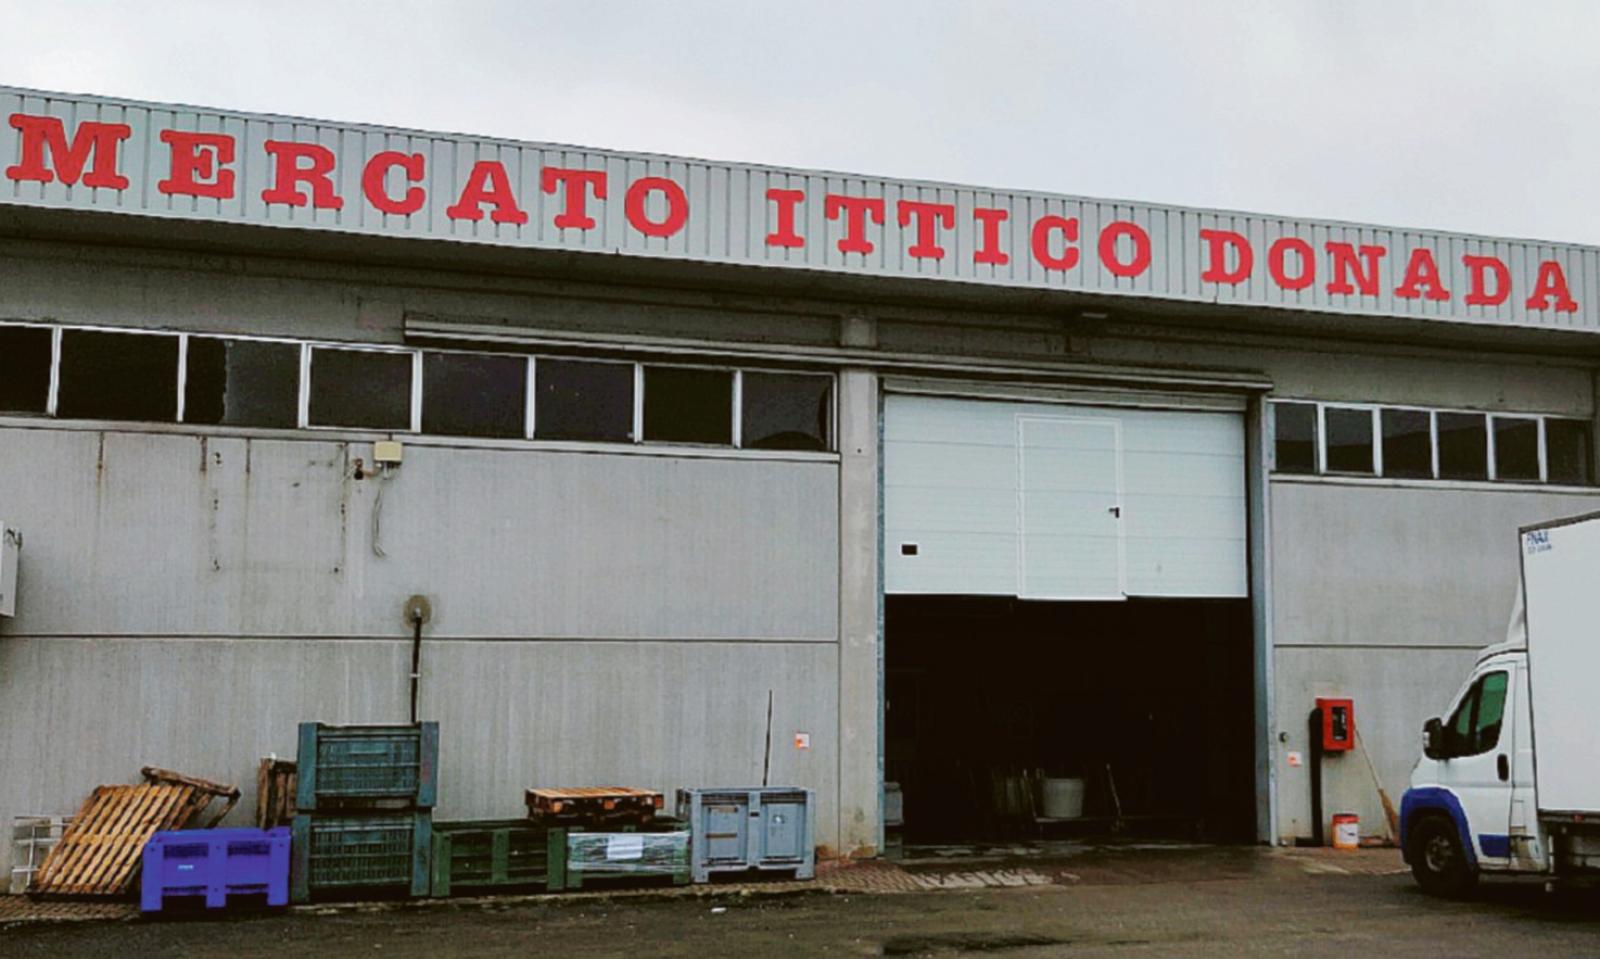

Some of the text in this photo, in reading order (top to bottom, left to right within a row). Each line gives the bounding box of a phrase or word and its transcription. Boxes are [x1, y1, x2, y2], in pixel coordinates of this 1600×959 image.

[7, 114, 1577, 312] MERCATO ITTICO DONADA
